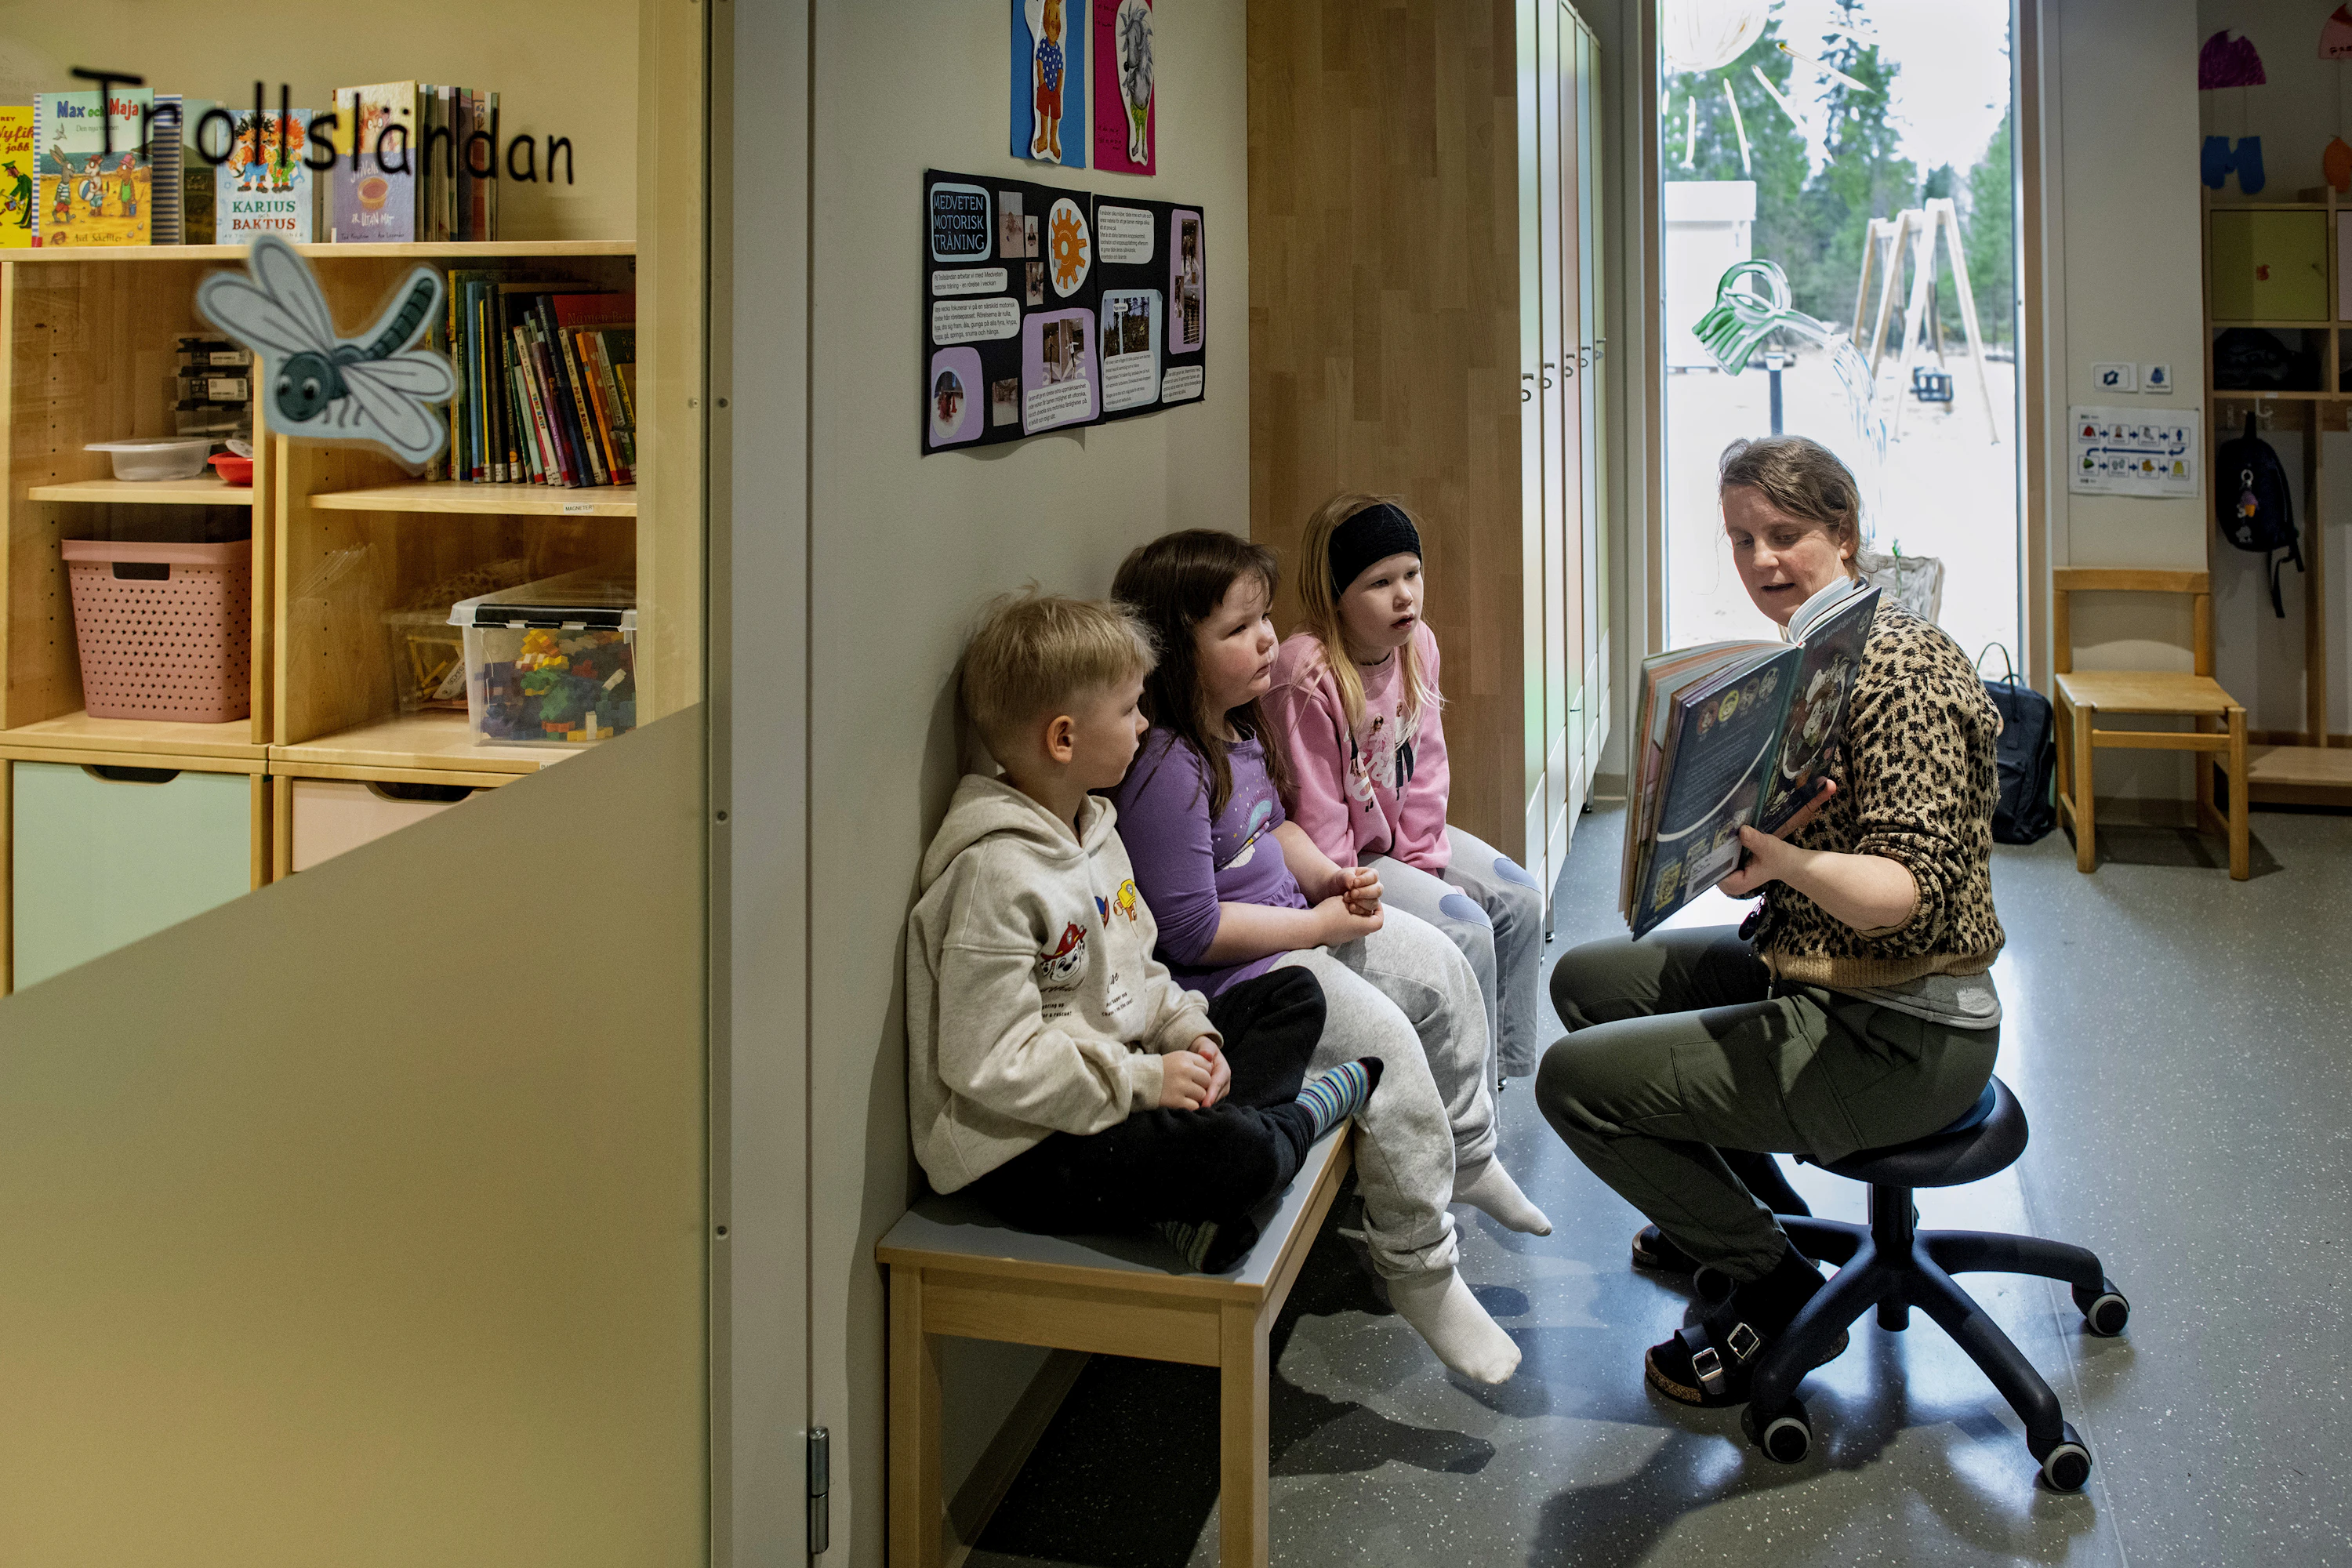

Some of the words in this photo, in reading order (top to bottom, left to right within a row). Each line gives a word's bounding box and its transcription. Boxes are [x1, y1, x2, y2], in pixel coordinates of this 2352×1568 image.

[56, 100, 85, 118] Max
[109, 98, 139, 121] Maja
[69, 65, 575, 186] Trollsländan
[5, 142, 30, 154] jobb
[232, 201, 296, 212] KARIUS
[933, 194, 983, 211] MEDVETEN
[232, 218, 296, 230] BAKTUS
[934, 214, 984, 230] MOTORISK
[934, 231, 985, 250] TRÄNING
[618, 379, 627, 397] WOLDE
[532, 393, 540, 408] VEMS
